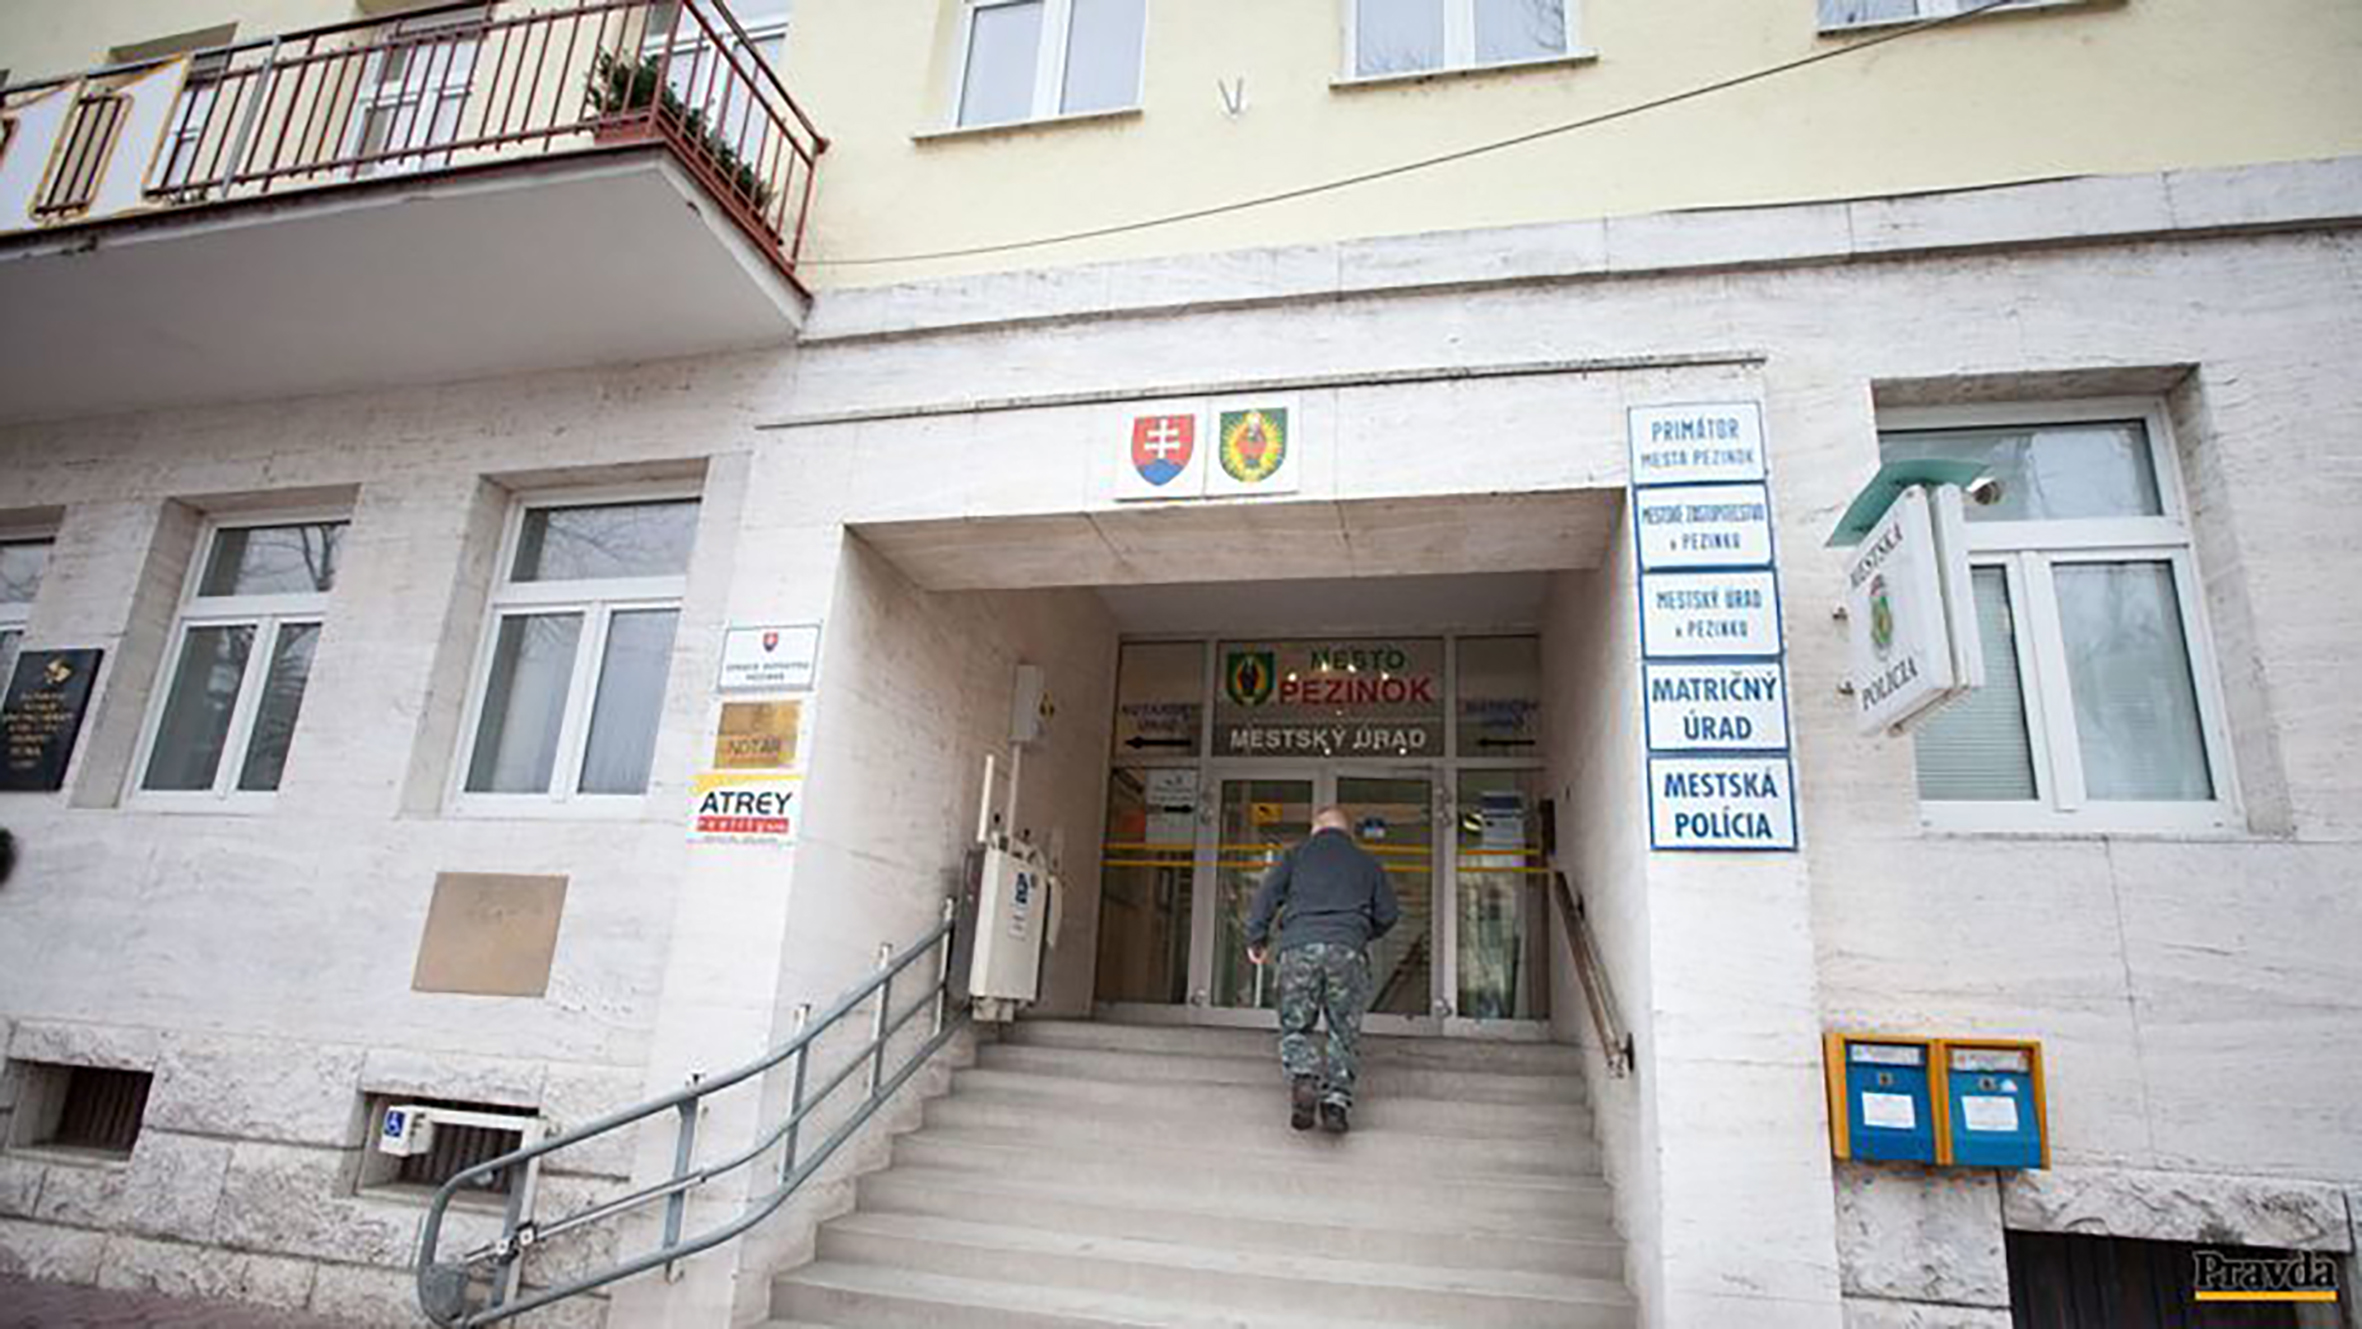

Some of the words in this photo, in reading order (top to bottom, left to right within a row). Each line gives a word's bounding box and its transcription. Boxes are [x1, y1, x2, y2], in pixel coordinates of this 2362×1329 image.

[1652, 415, 1739, 442] PRIMÁTOR
[1693, 448, 1753, 466] PEZINOK
[1310, 649, 1405, 670] MESTO
[1280, 676, 1432, 704] PEZINOK
[1652, 670, 1777, 702] MATRIČNÝ
[1683, 708, 1752, 740] ÚRAD
[1664, 766, 1778, 798] MESTSKÁ
[699, 791, 793, 815] ATREY
[1675, 805, 1773, 839] POLÍCIA
